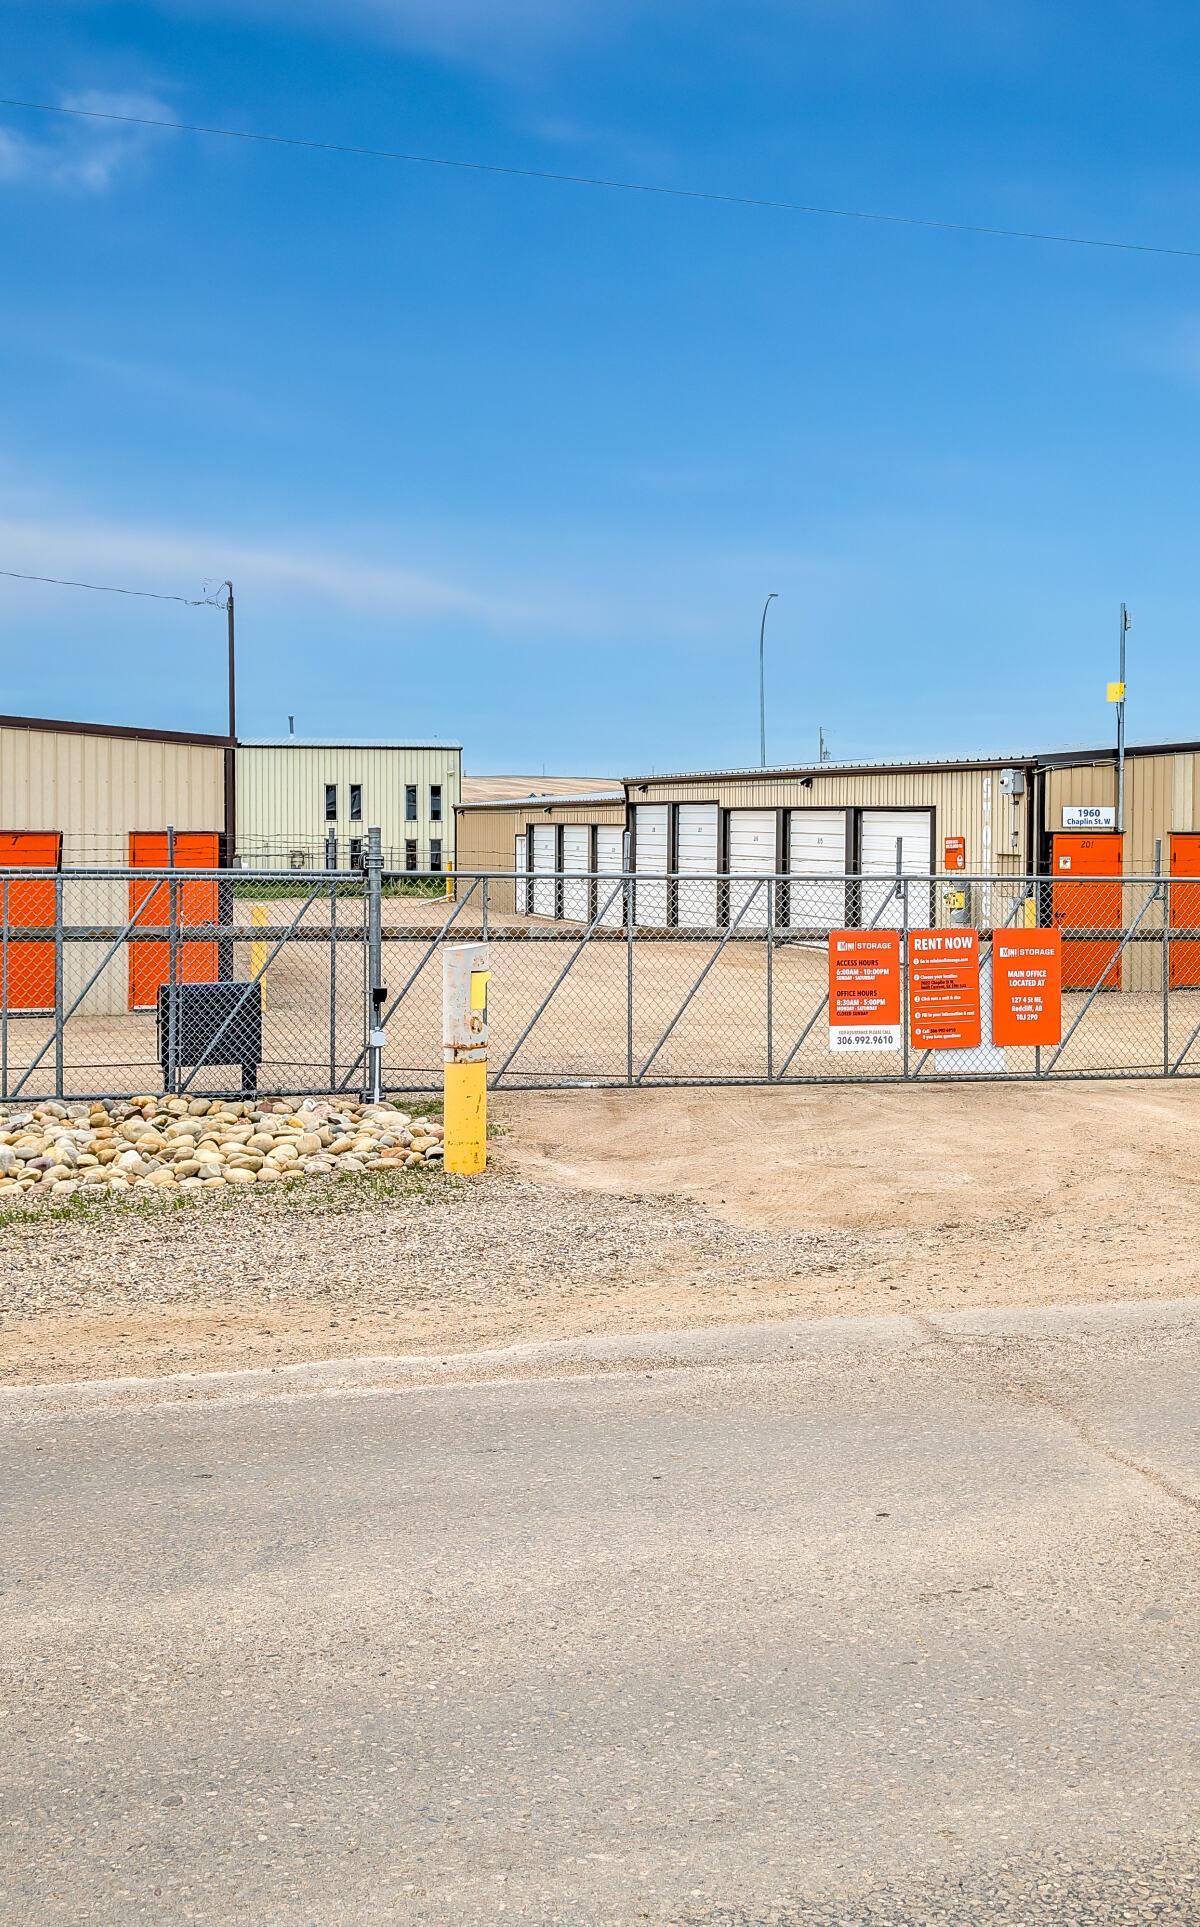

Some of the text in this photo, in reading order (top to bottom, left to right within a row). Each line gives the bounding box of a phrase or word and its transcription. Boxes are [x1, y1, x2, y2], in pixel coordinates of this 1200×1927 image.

[1078, 809, 1101, 817] 1960
[1066, 818, 1093, 826] Chaplin
[914, 936, 973, 951] RENT NOW
[1020, 948, 1055, 956] STORAGE
[836, 968, 859, 976] 6:00AM
[1008, 970, 1047, 978] MAIN OFFICE
[1009, 979, 1046, 987] LOCATED AT
[863, 998, 886, 1006] 5:00PM
[1011, 1005, 1034, 1013] Redcliff,
[837, 1036, 894, 1045] 306.992.9610
